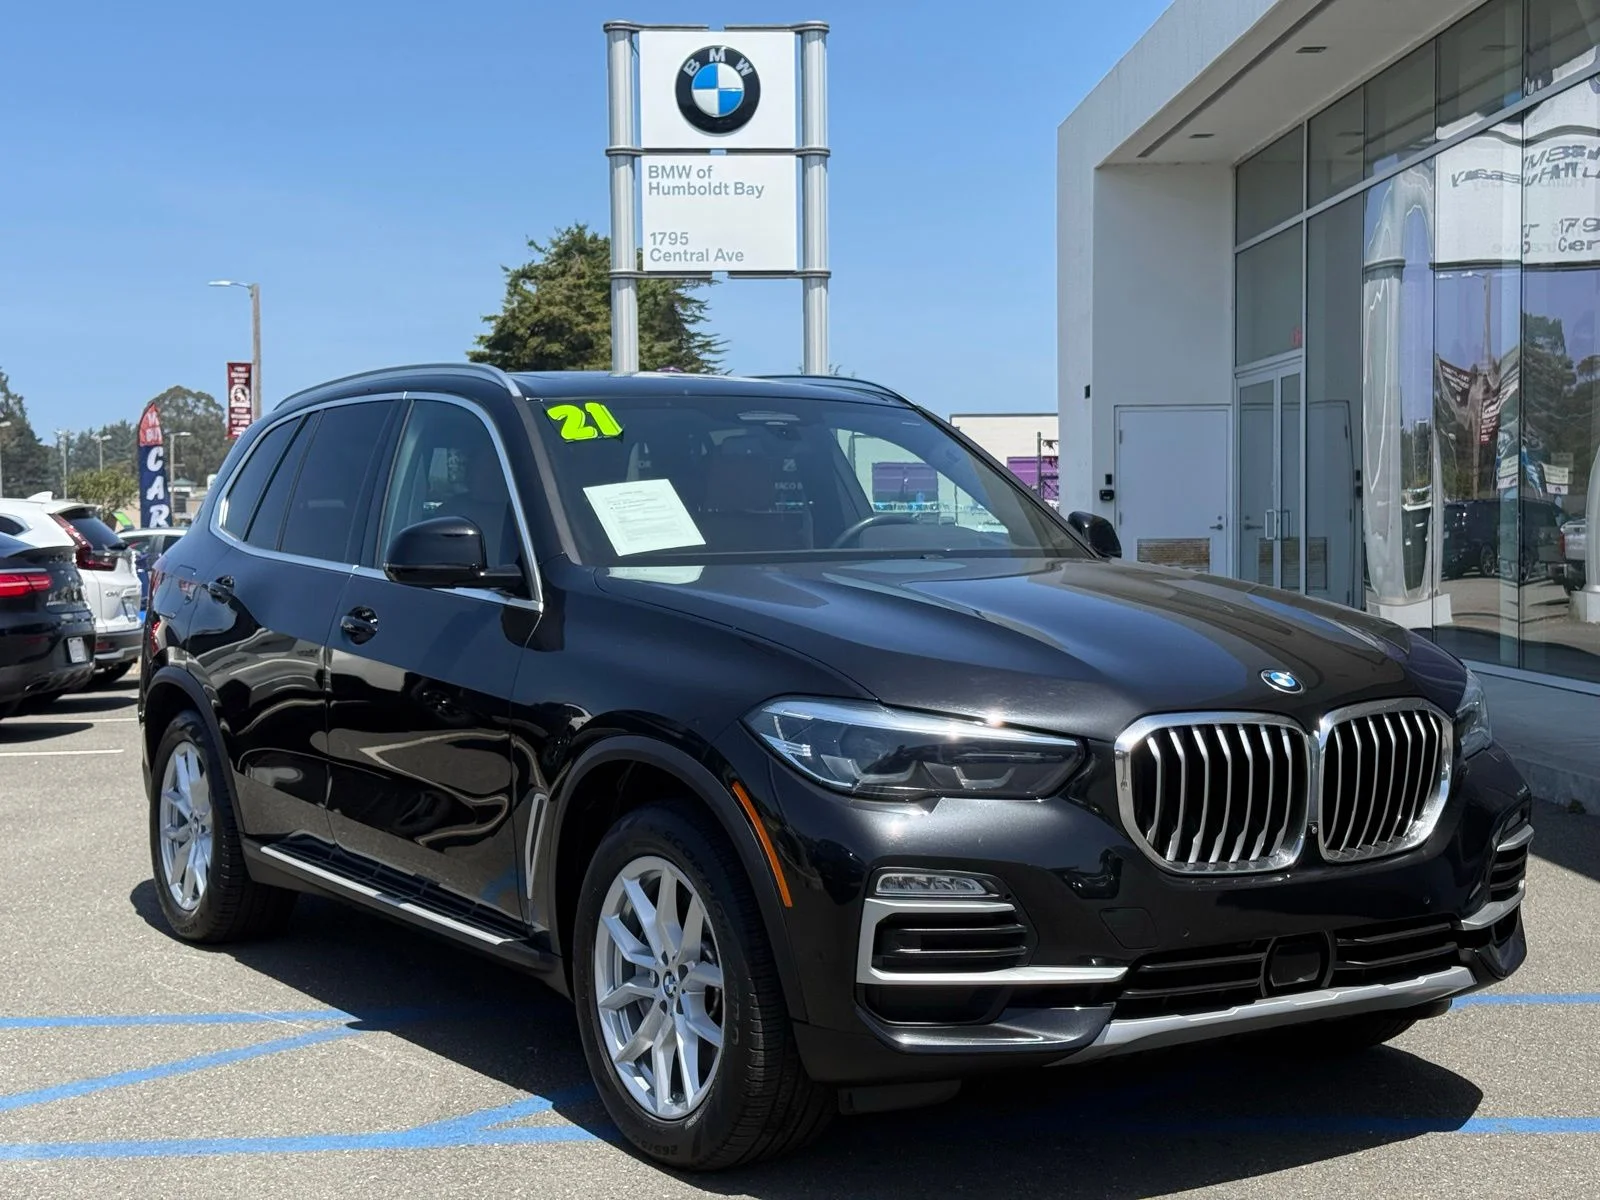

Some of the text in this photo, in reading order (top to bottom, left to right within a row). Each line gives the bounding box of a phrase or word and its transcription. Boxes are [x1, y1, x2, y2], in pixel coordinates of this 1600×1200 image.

[683, 48, 753, 77] BMW
[648, 165, 713, 179] BMW of
[648, 181, 765, 199] Humboldt Bay
[649, 231, 689, 246] 1795
[649, 248, 745, 263] Central Ave
[547, 402, 624, 442] 21
